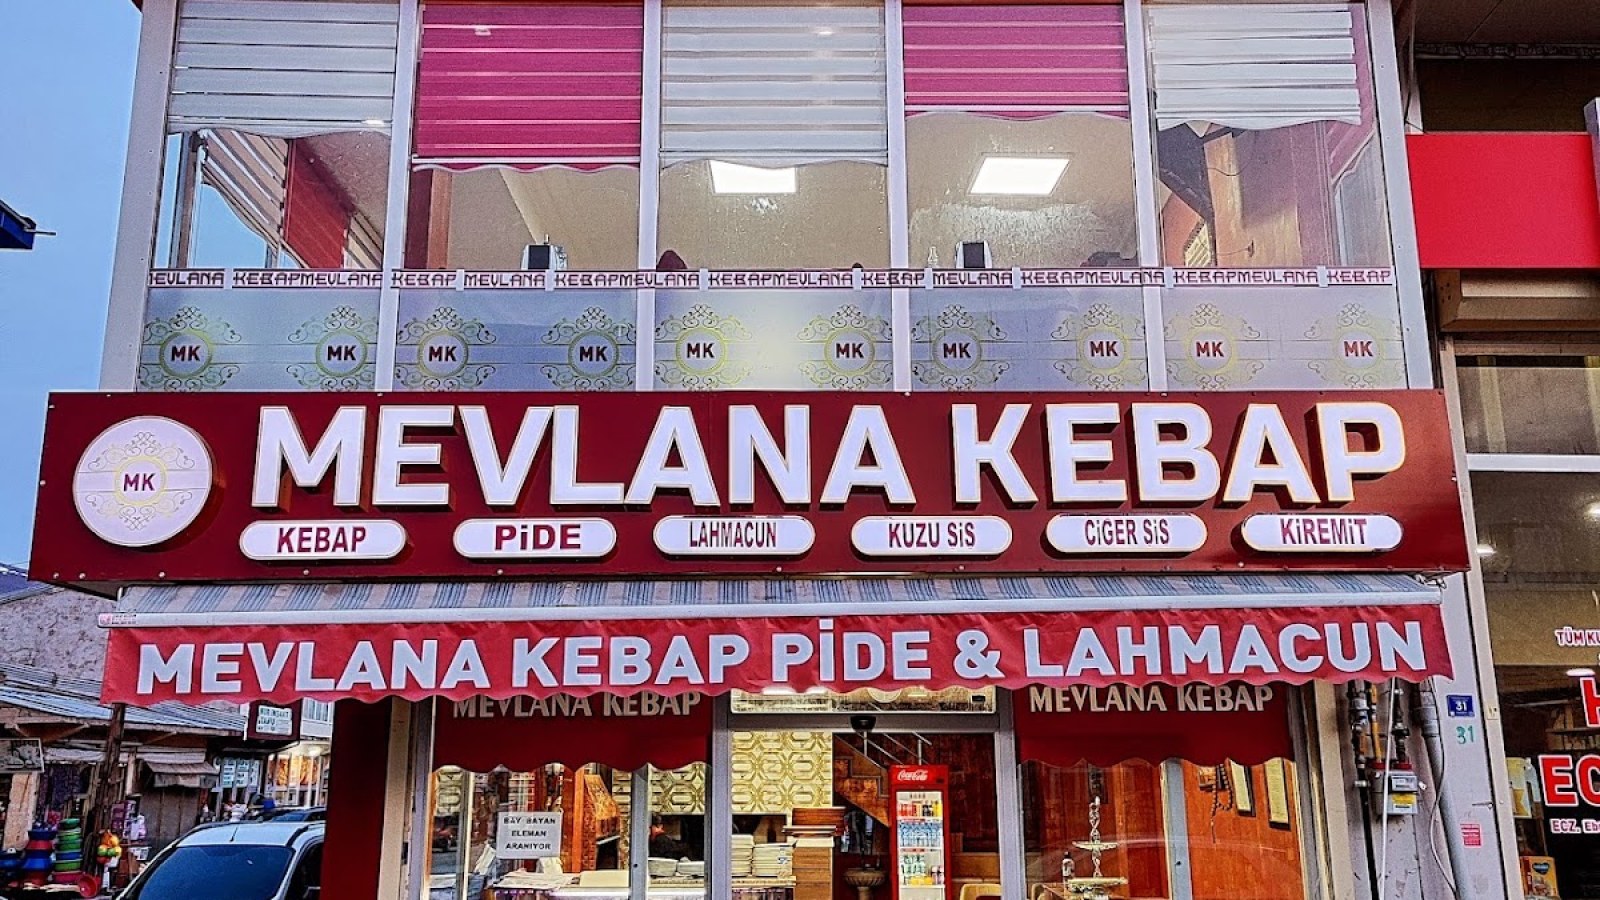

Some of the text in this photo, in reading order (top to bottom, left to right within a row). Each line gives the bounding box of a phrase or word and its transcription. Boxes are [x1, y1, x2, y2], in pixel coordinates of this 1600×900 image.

[391, 273, 456, 286] KEBAP
[464, 273, 545, 286] MEVLANA
[862, 273, 924, 285] KEBAP
[932, 272, 1012, 285] MEVLANA
[1327, 270, 1391, 282] KEBAP
[171, 346, 200, 361] MK
[327, 345, 356, 361] MK
[428, 346, 457, 362] MK
[579, 346, 608, 362] MK
[686, 343, 715, 358] MK
[836, 343, 864, 358] MK
[943, 343, 971, 358] MK
[1090, 341, 1119, 356] MK
[1196, 341, 1224, 357] MK
[1343, 341, 1372, 356] MK
[251, 402, 1406, 508] MEVLANA KEBAP
[123, 473, 155, 491] MK
[277, 526, 366, 553] KEBAP
[689, 521, 777, 548] LAHMACUN
[889, 523, 940, 548] KUZU
[1554, 626, 1585, 646] TÜM
[137, 639, 491, 694] MEVLANA
[511, 634, 749, 687] KEBAP
[954, 630, 1005, 679] &
[1023, 621, 1427, 678] LAHMACUN
[453, 689, 701, 718] MEVLANA KEBAP
[1029, 684, 1273, 713] MEVLANA KEBAP
[1456, 701, 1468, 711] 31
[1456, 725, 1474, 744] 31
[503, 816, 522, 825] BAY
[505, 842, 552, 850] ARANIYOR
